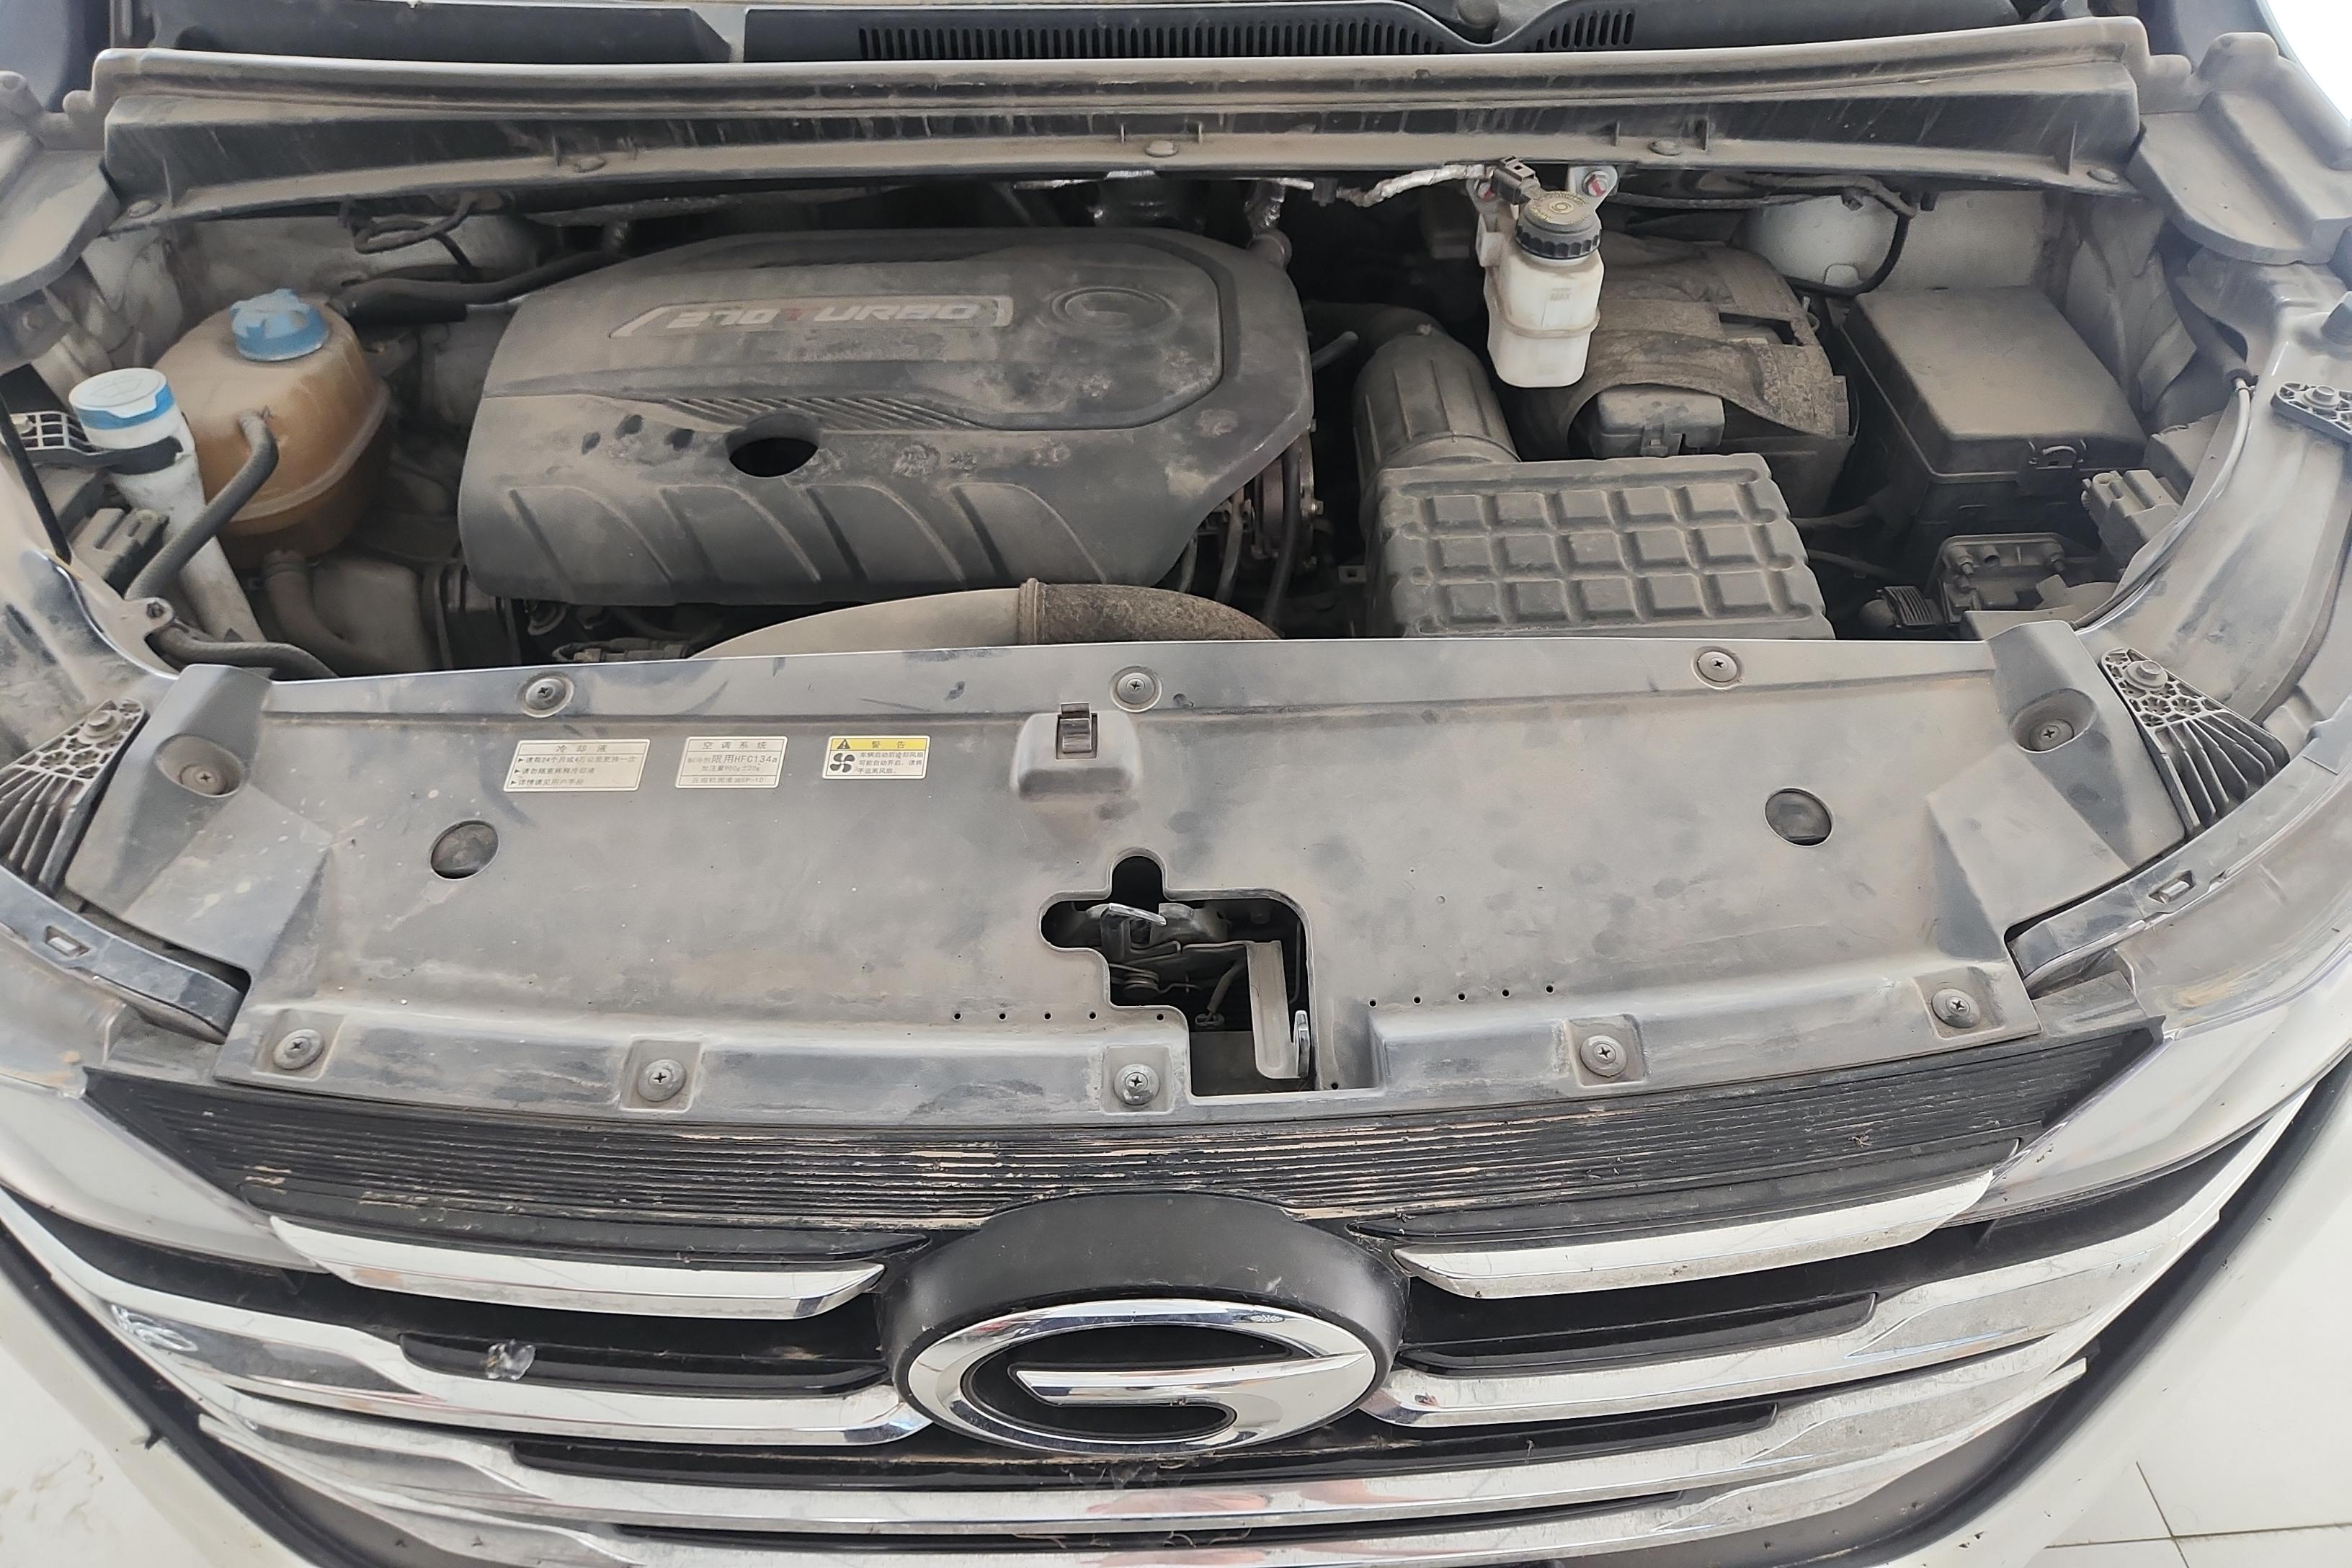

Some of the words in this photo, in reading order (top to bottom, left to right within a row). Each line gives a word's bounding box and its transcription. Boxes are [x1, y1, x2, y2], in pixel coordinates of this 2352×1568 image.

[556, 744, 607, 753] 冷却液
[703, 741, 767, 749] 空调系统
[872, 740, 906, 749] 警告
